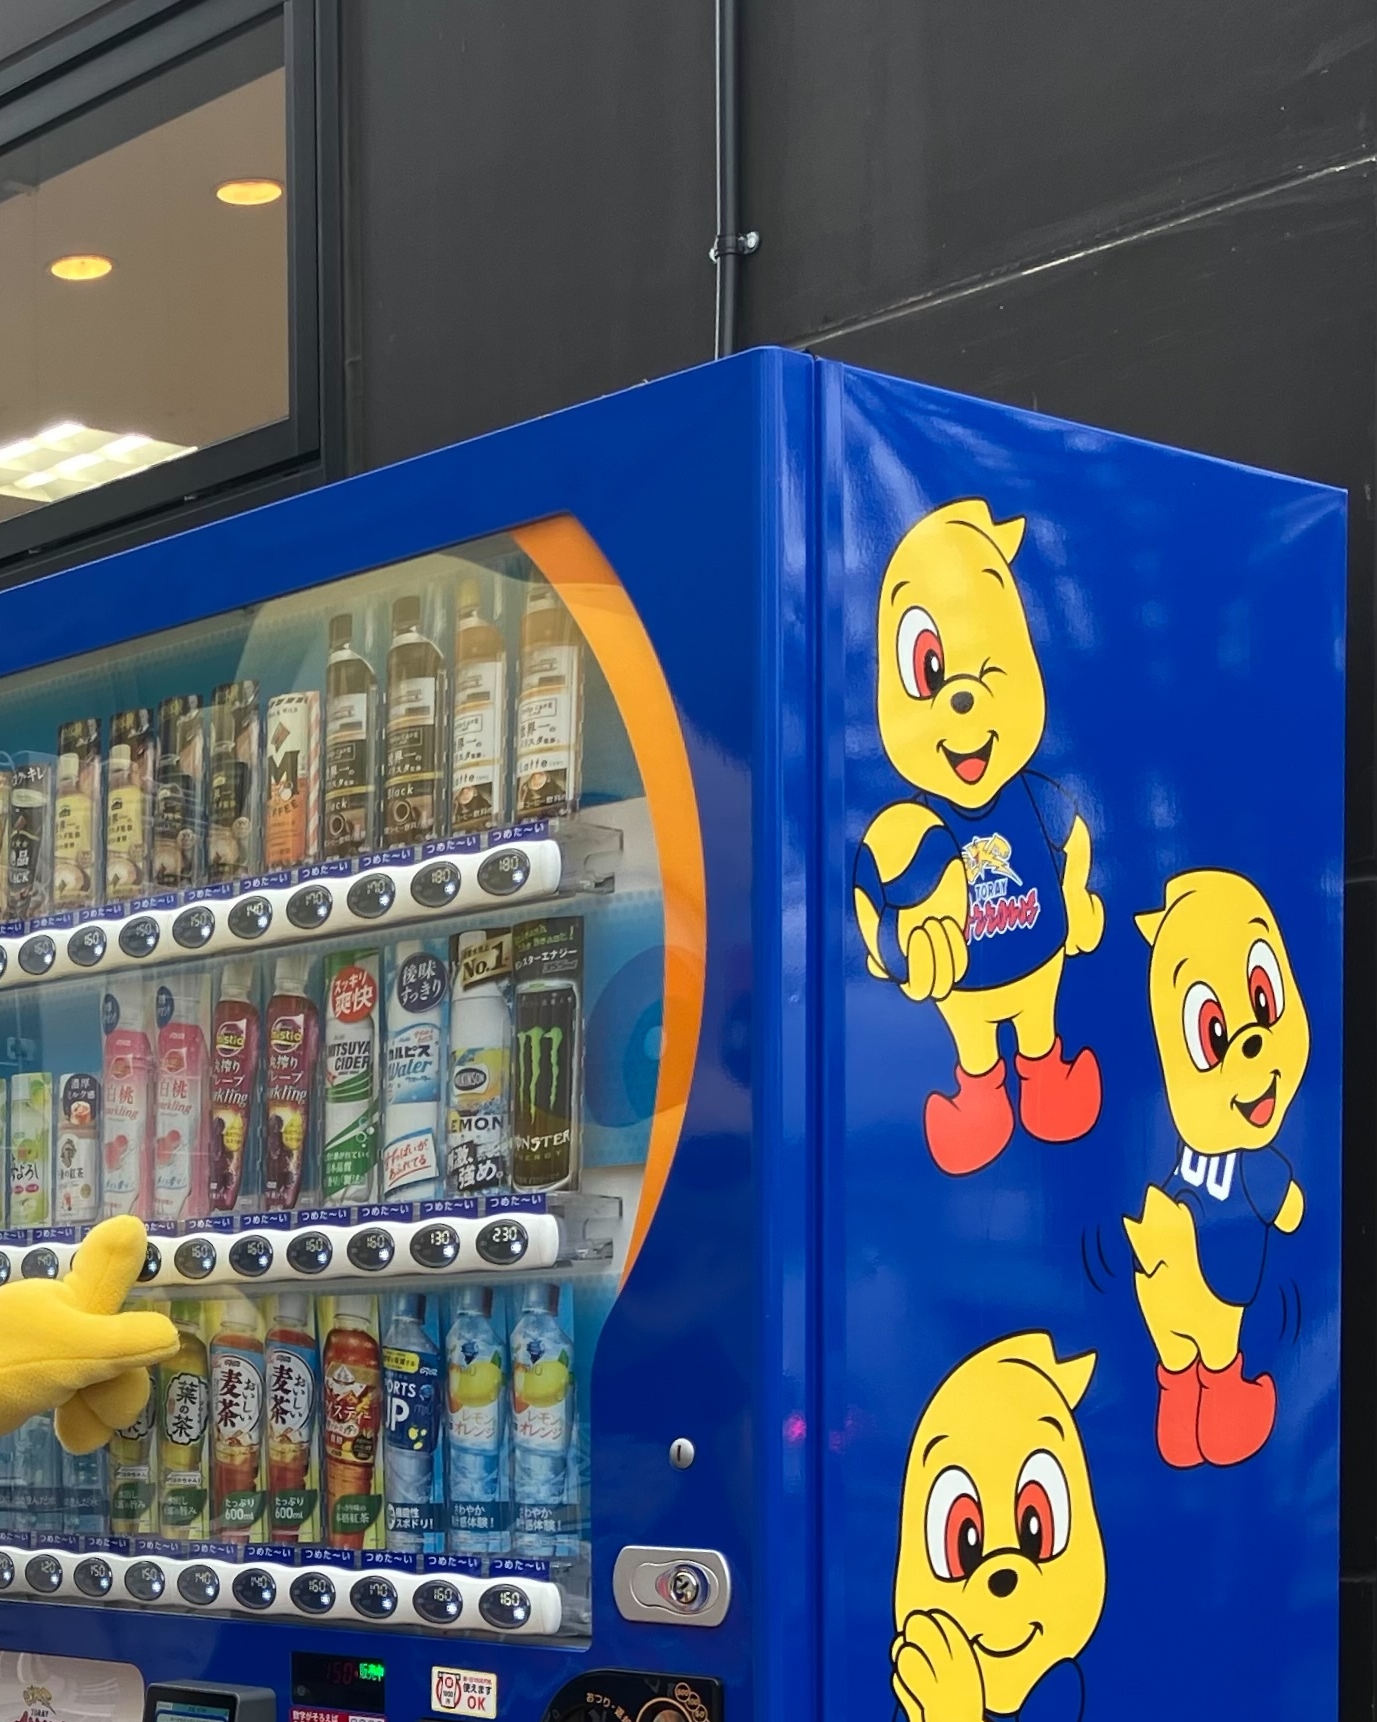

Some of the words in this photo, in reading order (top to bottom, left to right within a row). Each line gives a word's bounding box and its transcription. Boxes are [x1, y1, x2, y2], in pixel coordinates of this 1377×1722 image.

[499, 856, 519, 871] 180
[432, 869, 450, 884] 180
[975, 878, 1008, 899] TORAY
[463, 941, 507, 979] No.1
[402, 960, 437, 982] 後味
[334, 970, 367, 993] スッキリ
[400, 981, 443, 1005] すっきり
[335, 985, 373, 1018] 爽快
[335, 1056, 370, 1071] CIDER
[450, 1116, 503, 1133] EMON
[367, 1234, 384, 1249] 160
[431, 1231, 449, 1245] 130
[493, 1226, 517, 1242] 230
[306, 1238, 322, 1252] 160
[218, 1369, 242, 1427] 麦茶
[270, 1365, 292, 1424] 麦茶
[172, 1381, 199, 1438] 葉の茶
[519, 1421, 563, 1440] オレンジ
[225, 1498, 255, 1508] たっぷり
[275, 1497, 304, 1507] たっぷり
[225, 1508, 254, 1520] 600ml
[275, 1507, 303, 1519] 600ml
[90, 1564, 105, 1577] 150
[309, 1580, 325, 1592] 160
[434, 1588, 452, 1602] 160
[500, 1592, 519, 1606] 160
[463, 1683, 492, 1695] 使えます
[467, 1696, 486, 1711] OK
